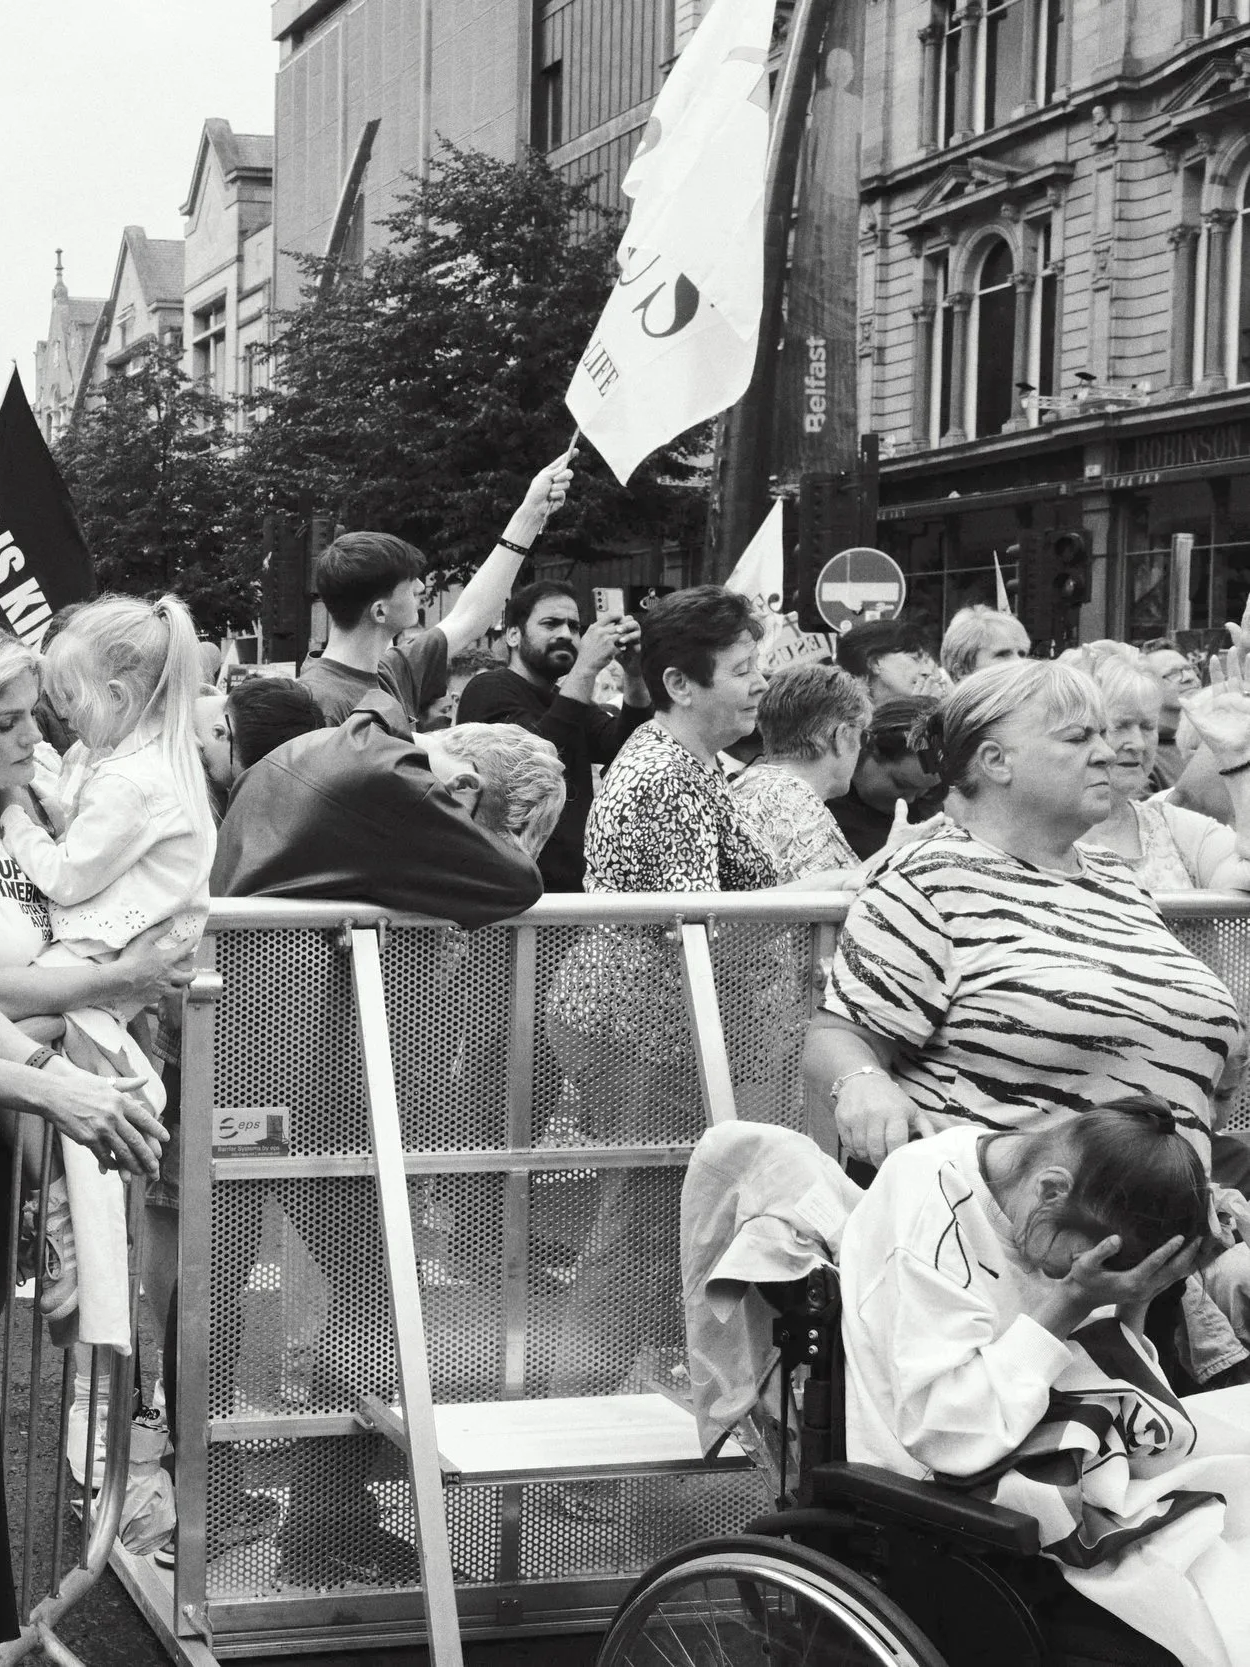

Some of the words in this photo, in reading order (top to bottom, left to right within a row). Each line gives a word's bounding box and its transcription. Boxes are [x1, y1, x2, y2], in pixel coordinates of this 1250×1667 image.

[583, 341, 619, 397] LIFE
[804, 335, 827, 433] Belfast
[31, 915, 52, 928] AUG
[238, 1121, 260, 1131] eps
